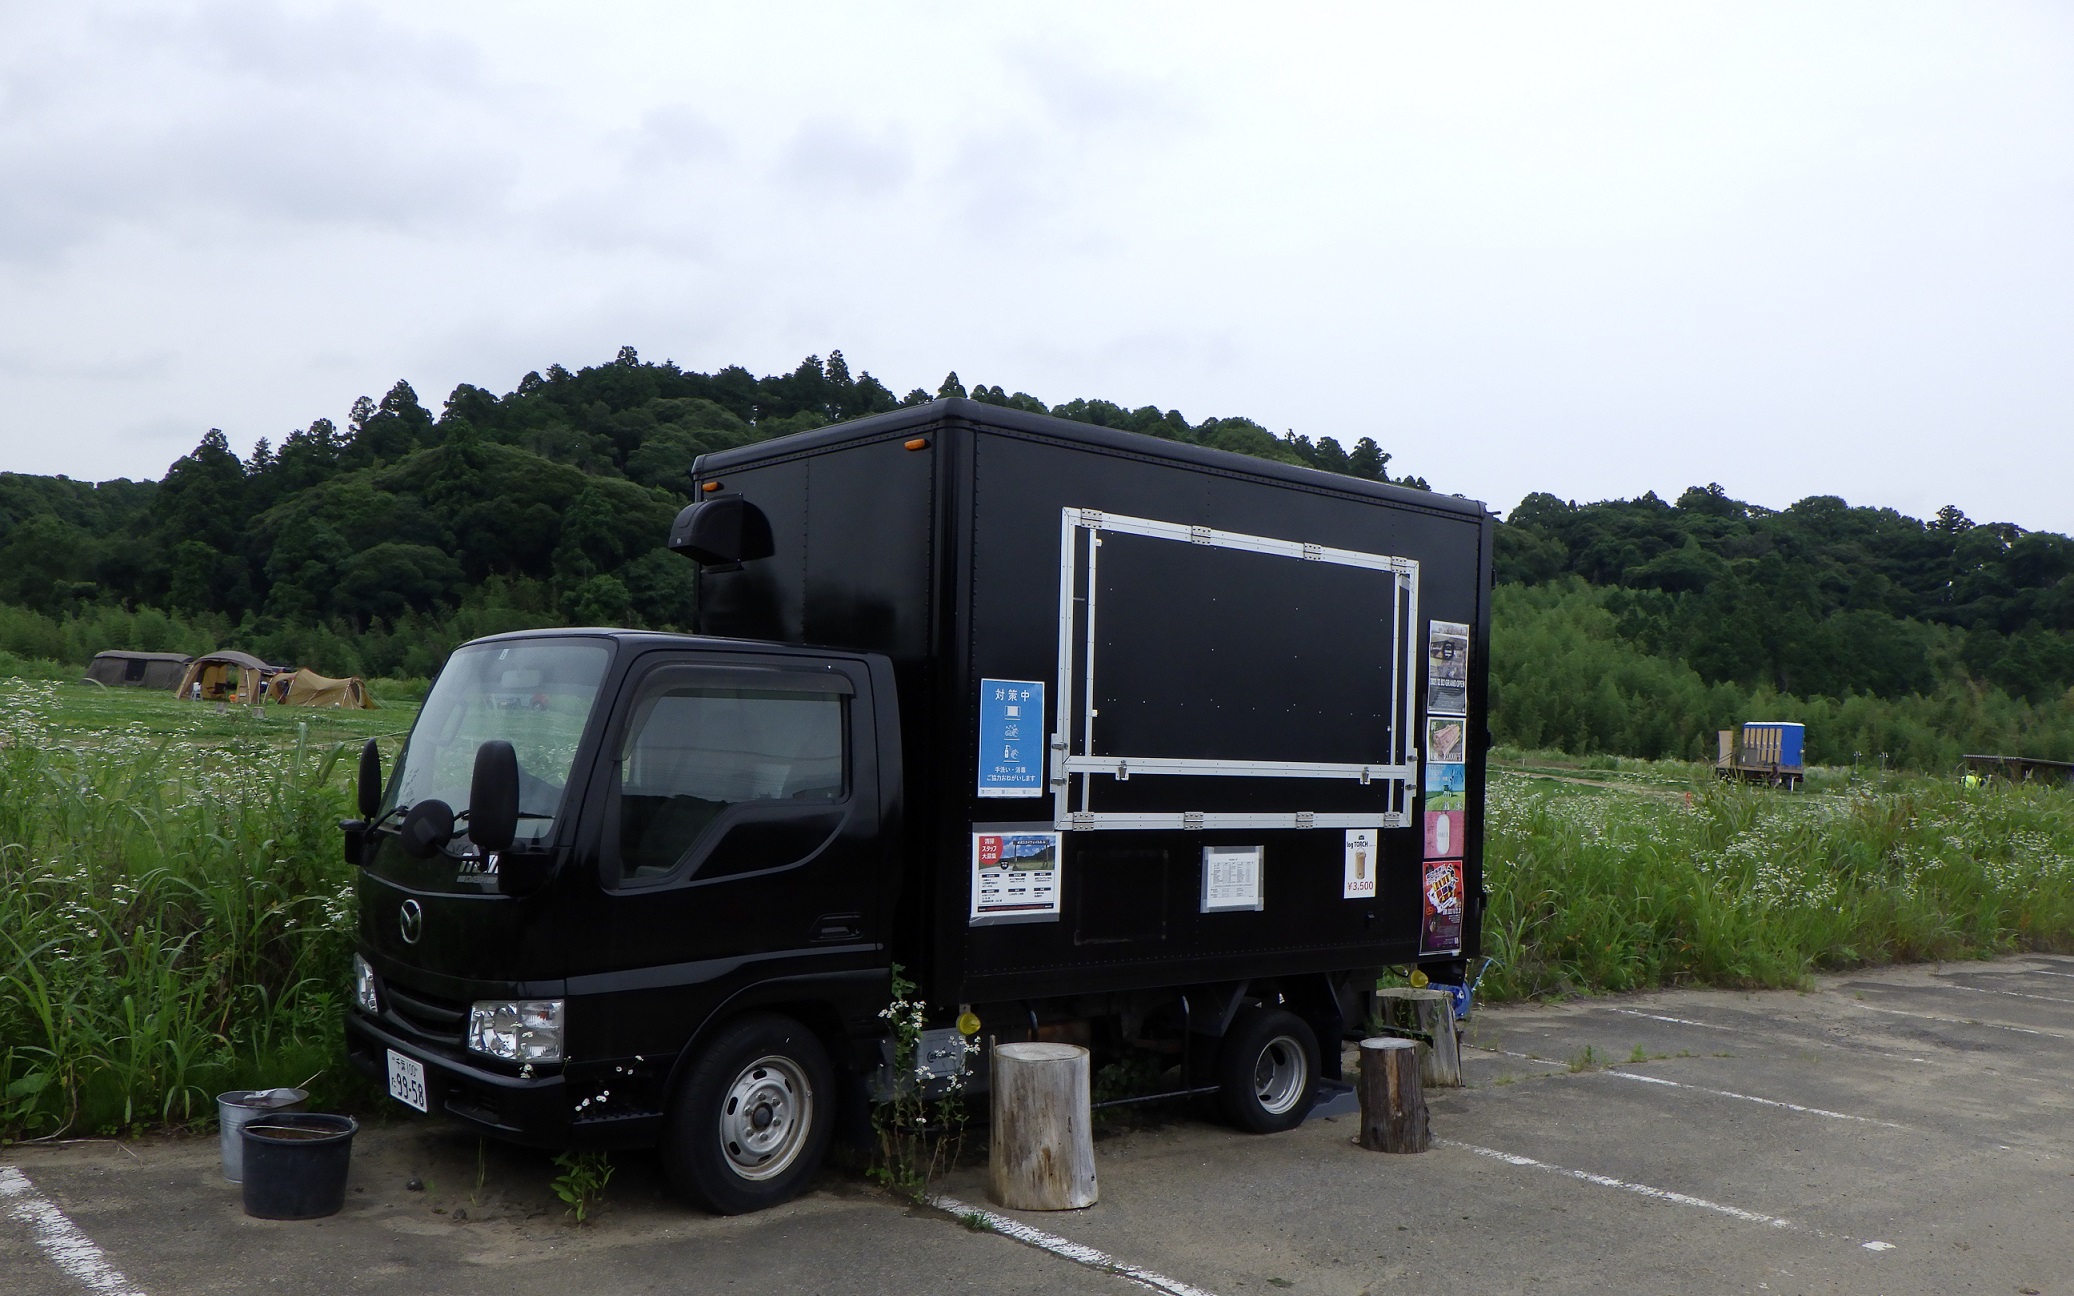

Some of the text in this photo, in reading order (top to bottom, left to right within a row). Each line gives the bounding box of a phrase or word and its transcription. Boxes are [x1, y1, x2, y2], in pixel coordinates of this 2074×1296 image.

[995, 688, 1030, 702] 対策中
[986, 774, 1036, 782] ご協力おねがいします
[1347, 881, 1374, 891] ¥3,500
[396, 1073, 424, 1107] 99-58
